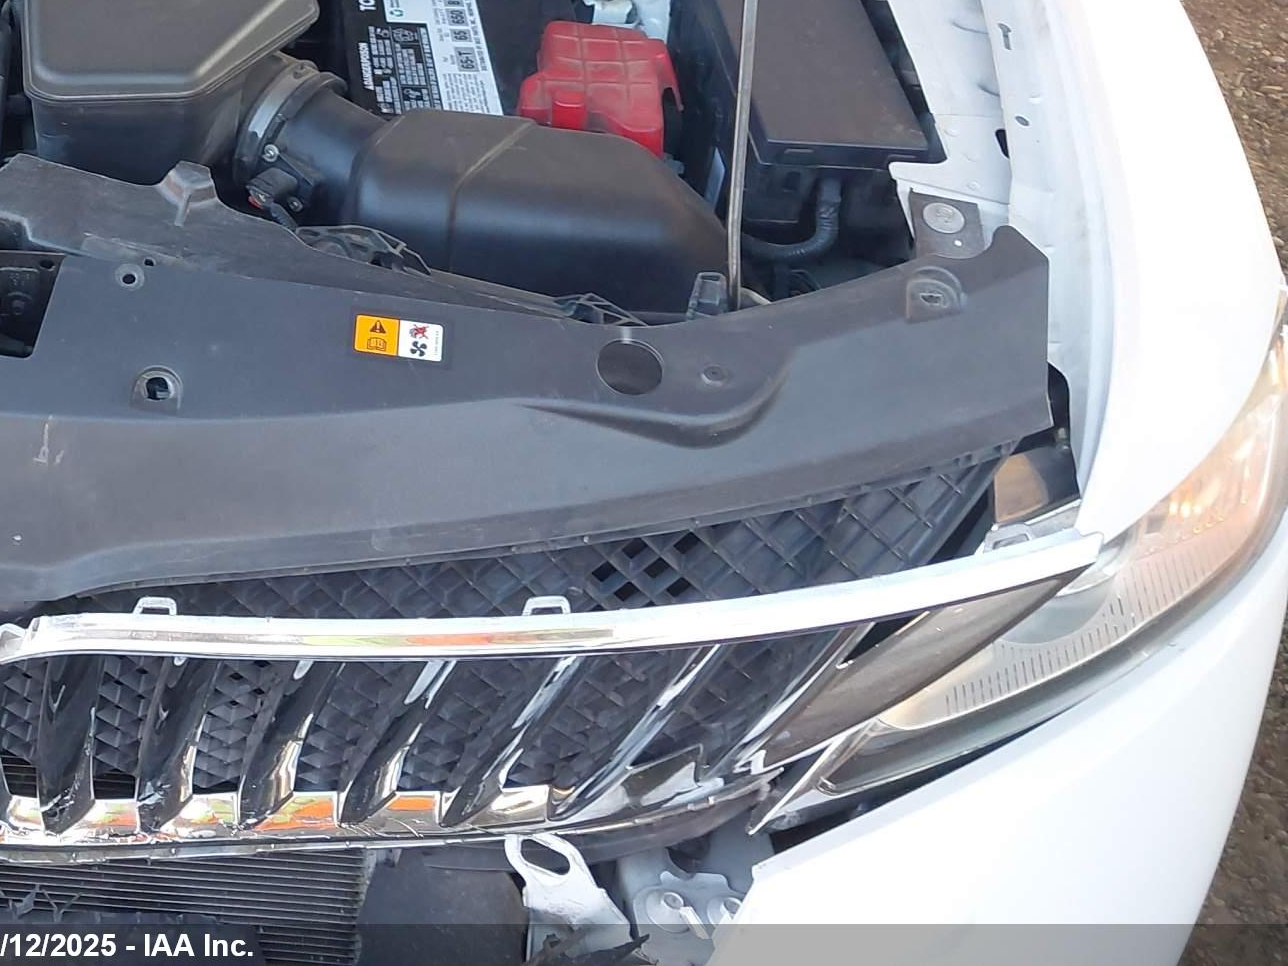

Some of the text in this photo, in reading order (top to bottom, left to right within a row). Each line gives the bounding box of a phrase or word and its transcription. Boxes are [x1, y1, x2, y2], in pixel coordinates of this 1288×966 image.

[450, 10, 464, 24] 650
[453, 30, 467, 42] 65
[459, 51, 475, 69] 65-T
